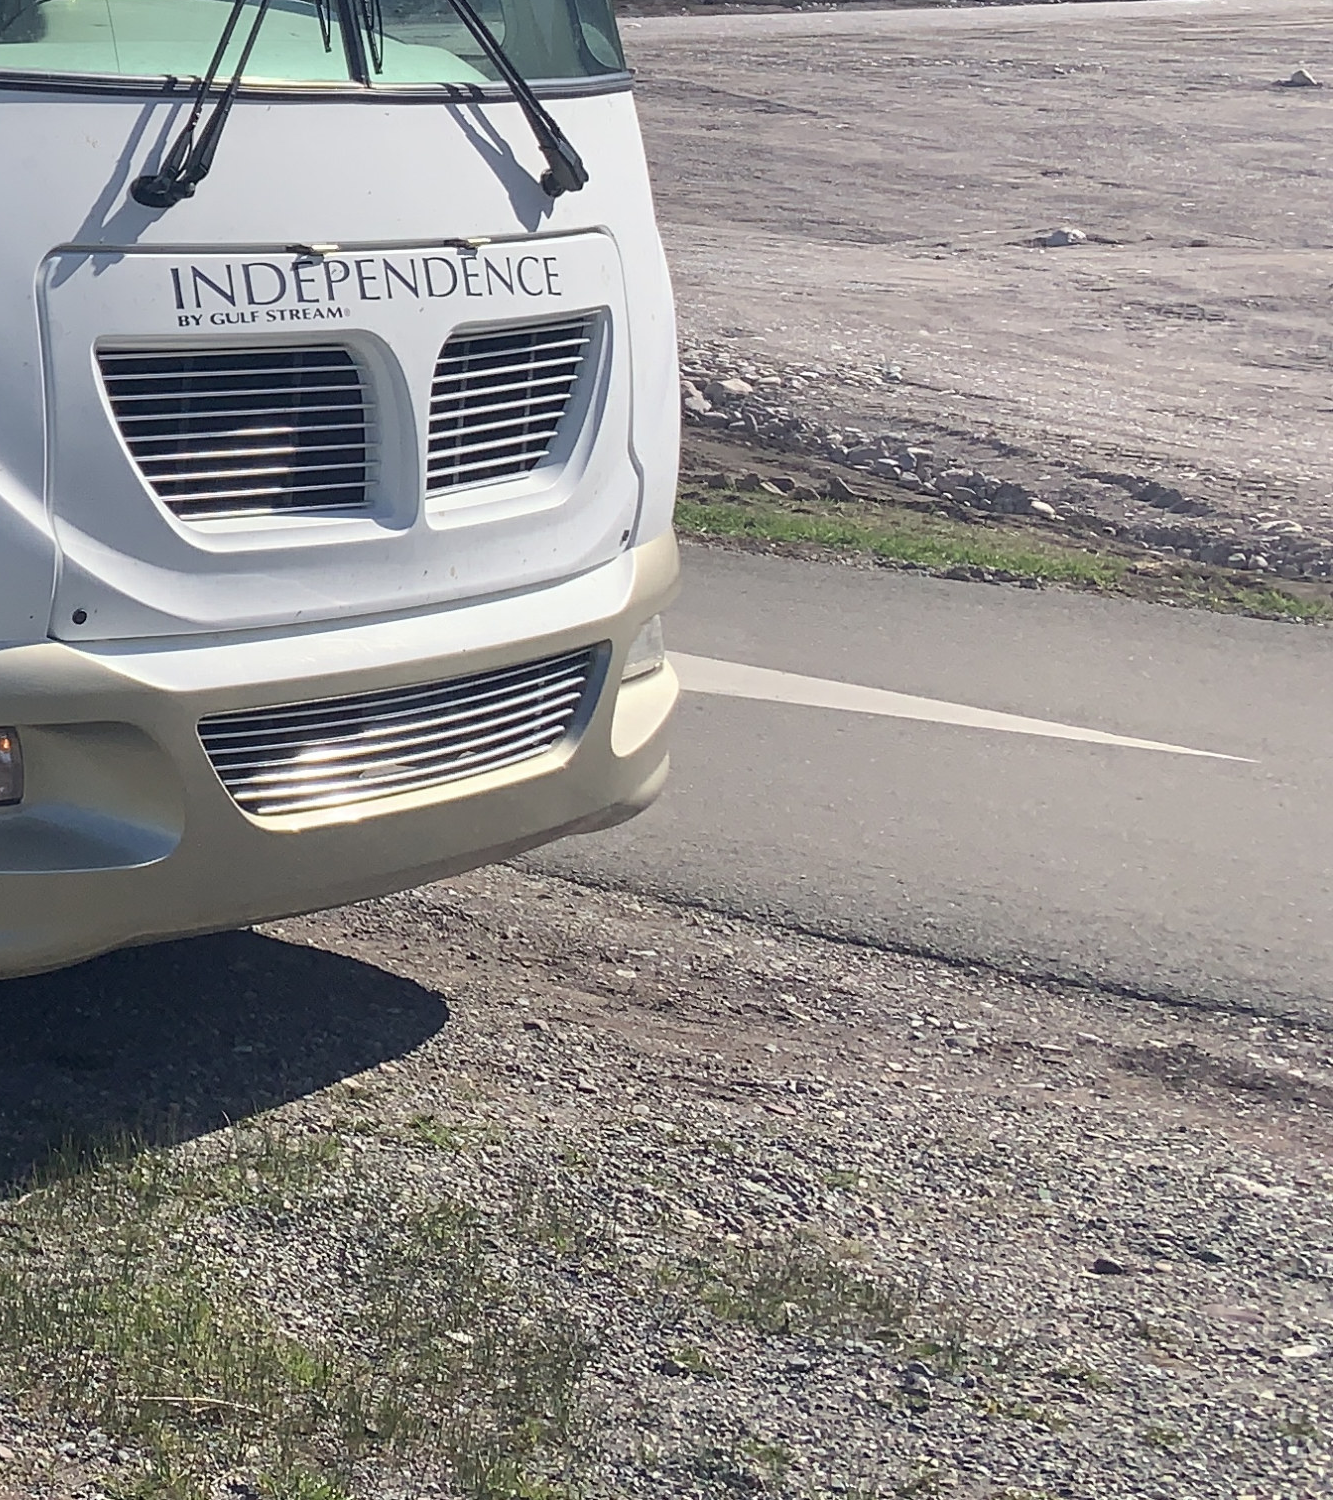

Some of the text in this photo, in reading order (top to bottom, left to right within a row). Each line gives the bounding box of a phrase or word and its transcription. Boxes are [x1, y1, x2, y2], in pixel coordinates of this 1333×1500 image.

[170, 257, 562, 309] INDEPENDENCE
[177, 314, 203, 327] BY
[210, 311, 259, 325] GULF
